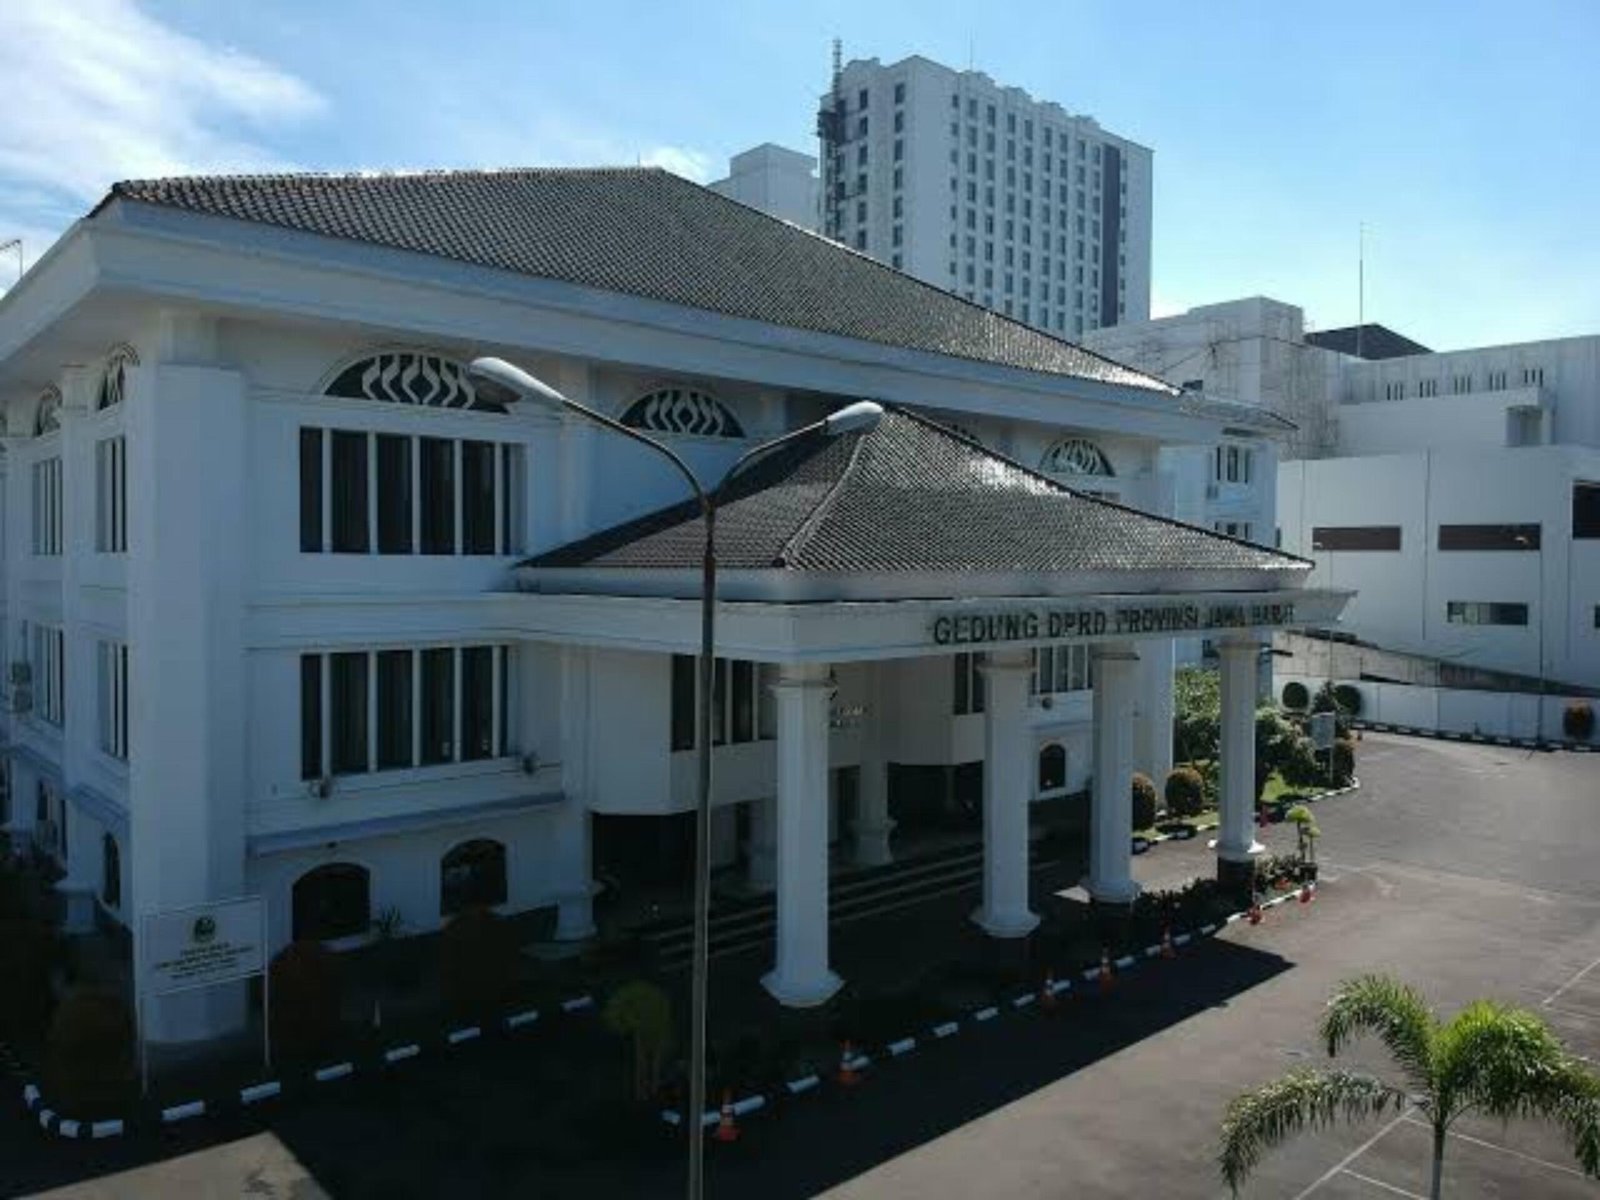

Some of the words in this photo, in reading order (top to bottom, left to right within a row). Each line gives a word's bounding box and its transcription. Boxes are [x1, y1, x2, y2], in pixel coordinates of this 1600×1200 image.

[934, 612, 1038, 645] GEDUNG
[1049, 609, 1106, 638] DPRD
[1116, 604, 1199, 633] PROVINSI
